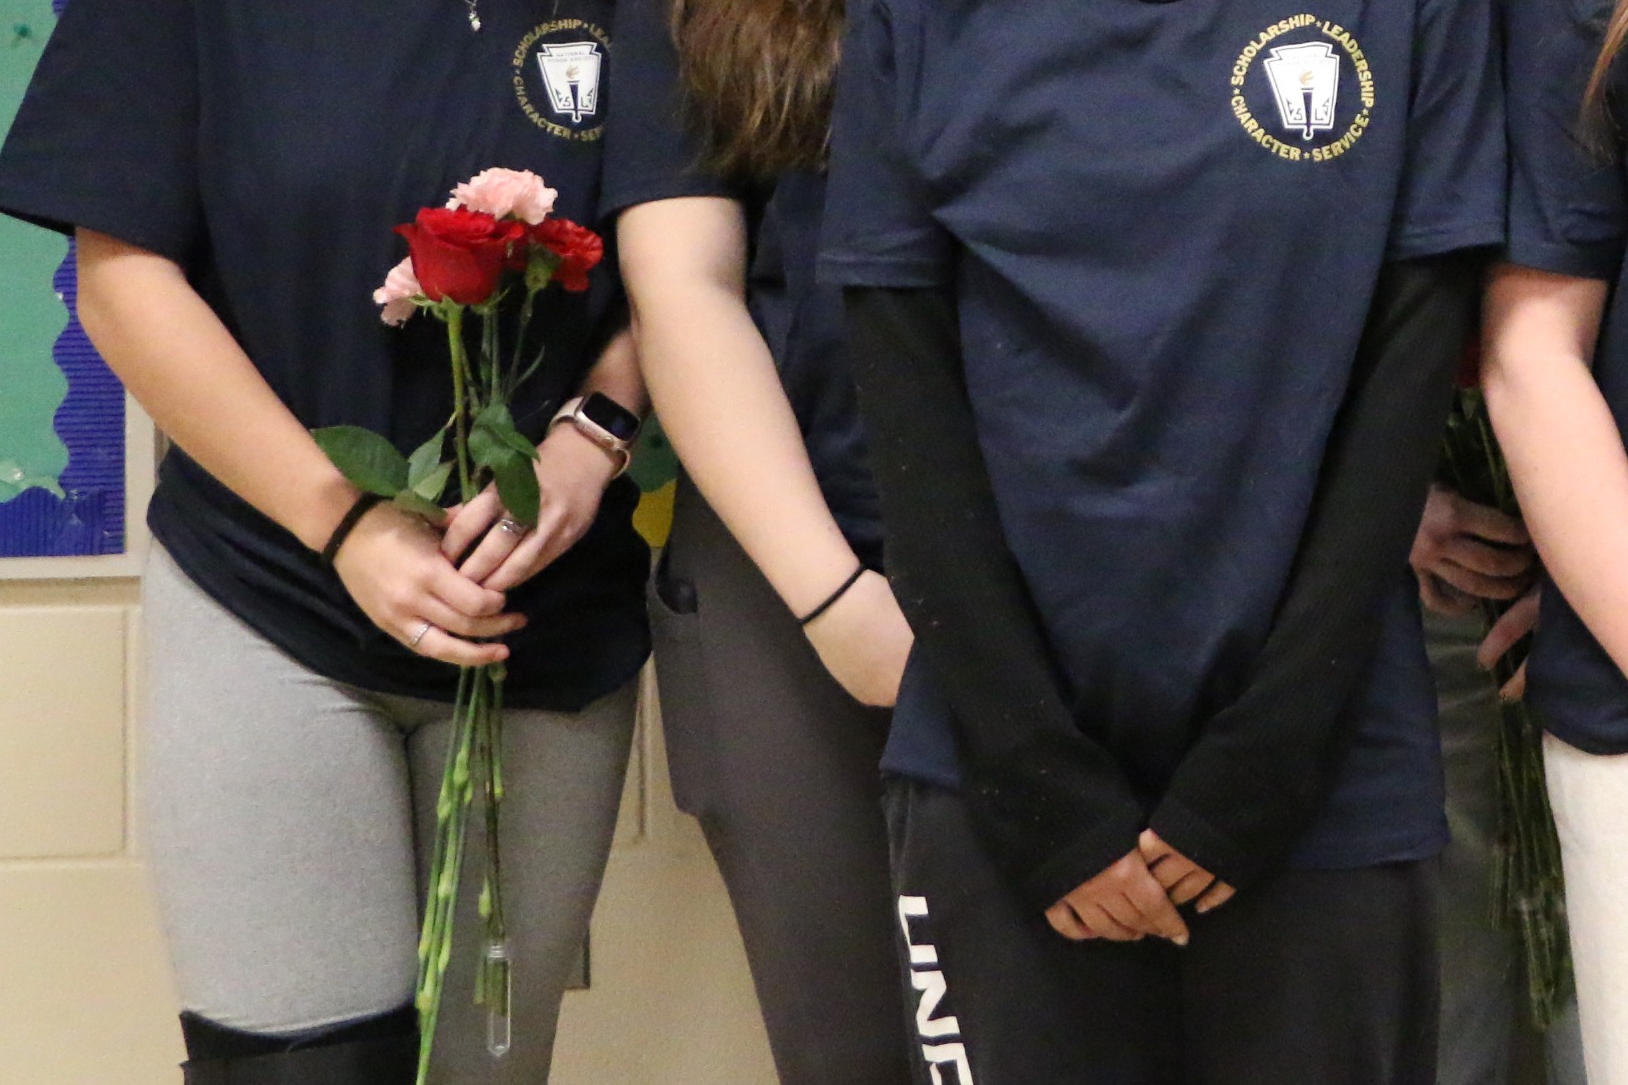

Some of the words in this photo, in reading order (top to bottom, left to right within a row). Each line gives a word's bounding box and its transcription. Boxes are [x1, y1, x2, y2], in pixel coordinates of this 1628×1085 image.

[1231, 13, 1316, 87] SCHOLARSHIP
[1321, 21, 1375, 108] LEADERSHIP
[1231, 95, 1302, 161] CHARACTER
[1311, 113, 1370, 163] SERVICE
